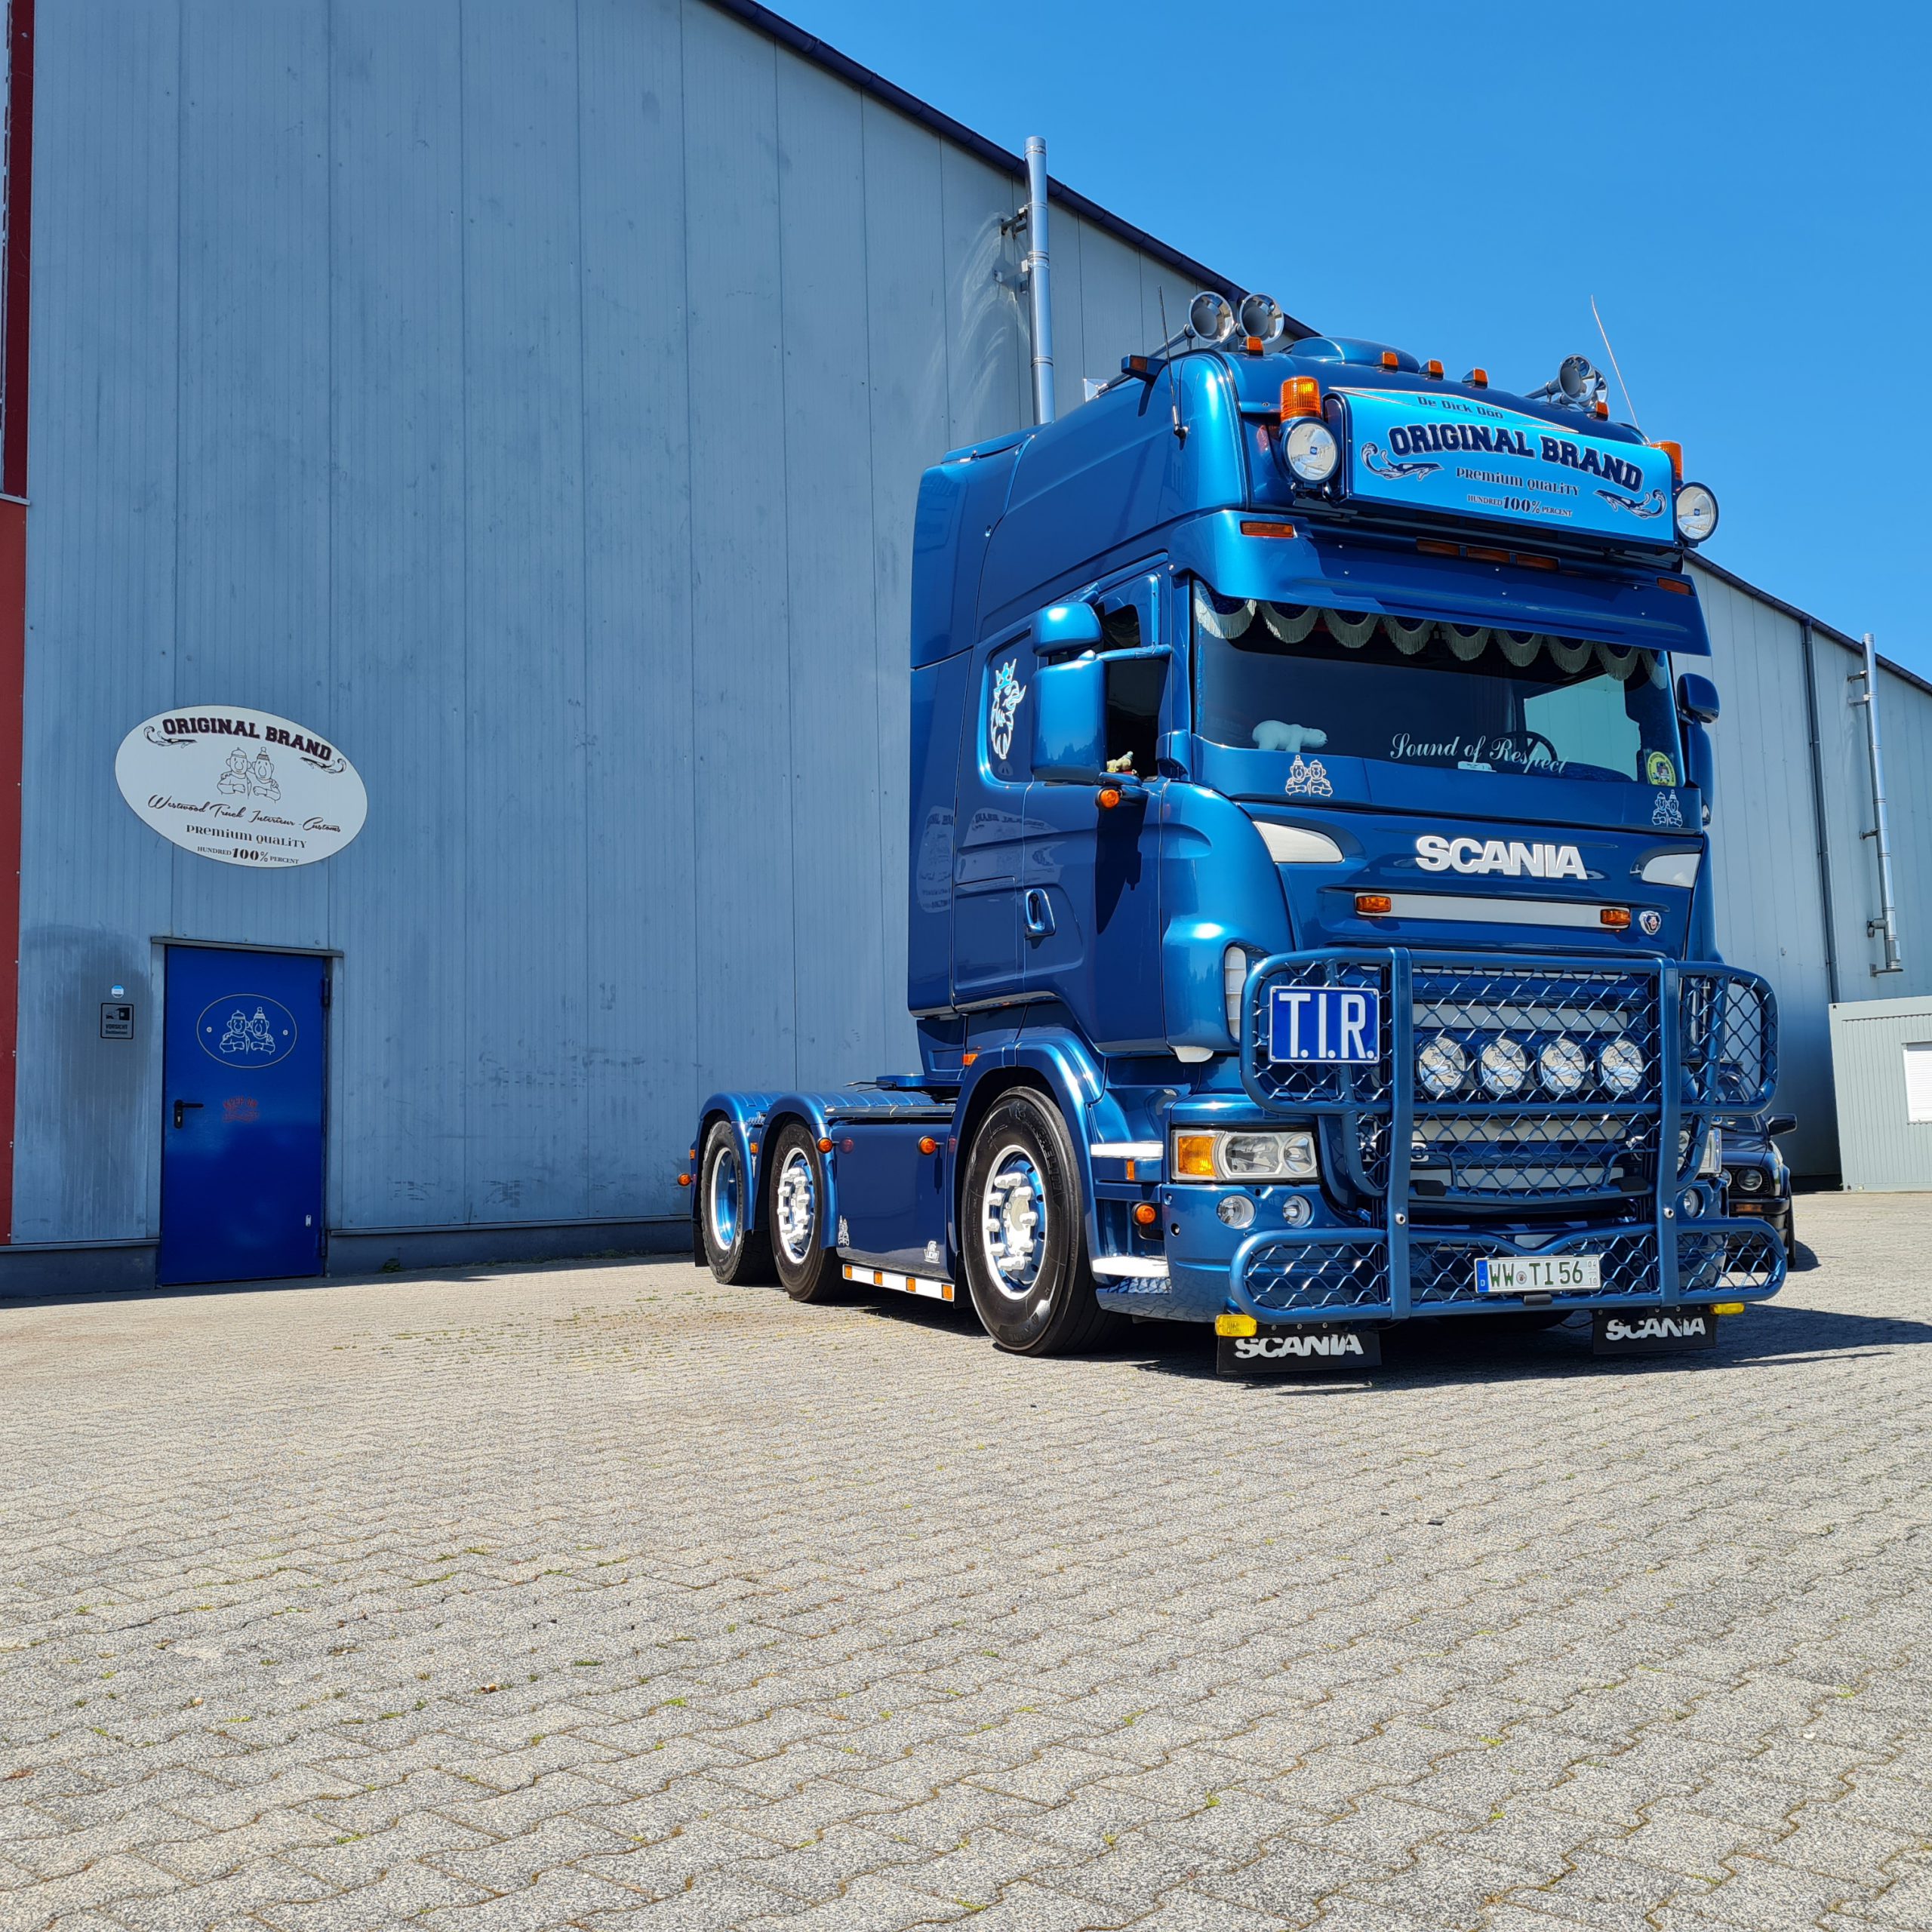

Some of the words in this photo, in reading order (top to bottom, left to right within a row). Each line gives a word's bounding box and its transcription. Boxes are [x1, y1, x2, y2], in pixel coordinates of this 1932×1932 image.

[1417, 396, 1437, 406] De
[1441, 400, 1472, 413] Dick
[1389, 424, 1536, 457] ORIGINAL
[1540, 435, 1644, 492] BRAND
[1467, 494, 1503, 506] HUNDRED
[1503, 496, 1541, 514] 100%
[1541, 506, 1572, 517] PERCENT
[162, 718, 260, 739] ORIGINAL
[265, 726, 332, 761] BRAND
[1390, 733, 1460, 759] Sound
[1463, 735, 1487, 763] of
[1489, 737, 1569, 774] Respect
[147, 794, 211, 813] Westwood
[209, 803, 247, 818] Truck
[197, 846, 232, 856] HUNDRED
[232, 848, 268, 862] 100%
[269, 856, 300, 864] PERCENT
[1414, 835, 1589, 880] SCANIA
[1278, 992, 1374, 1059] T.I.R.
[1488, 1263, 1515, 1287] WW
[1605, 1317, 1706, 1341] SCANIA
[1234, 1334, 1364, 1359] SCANIA
